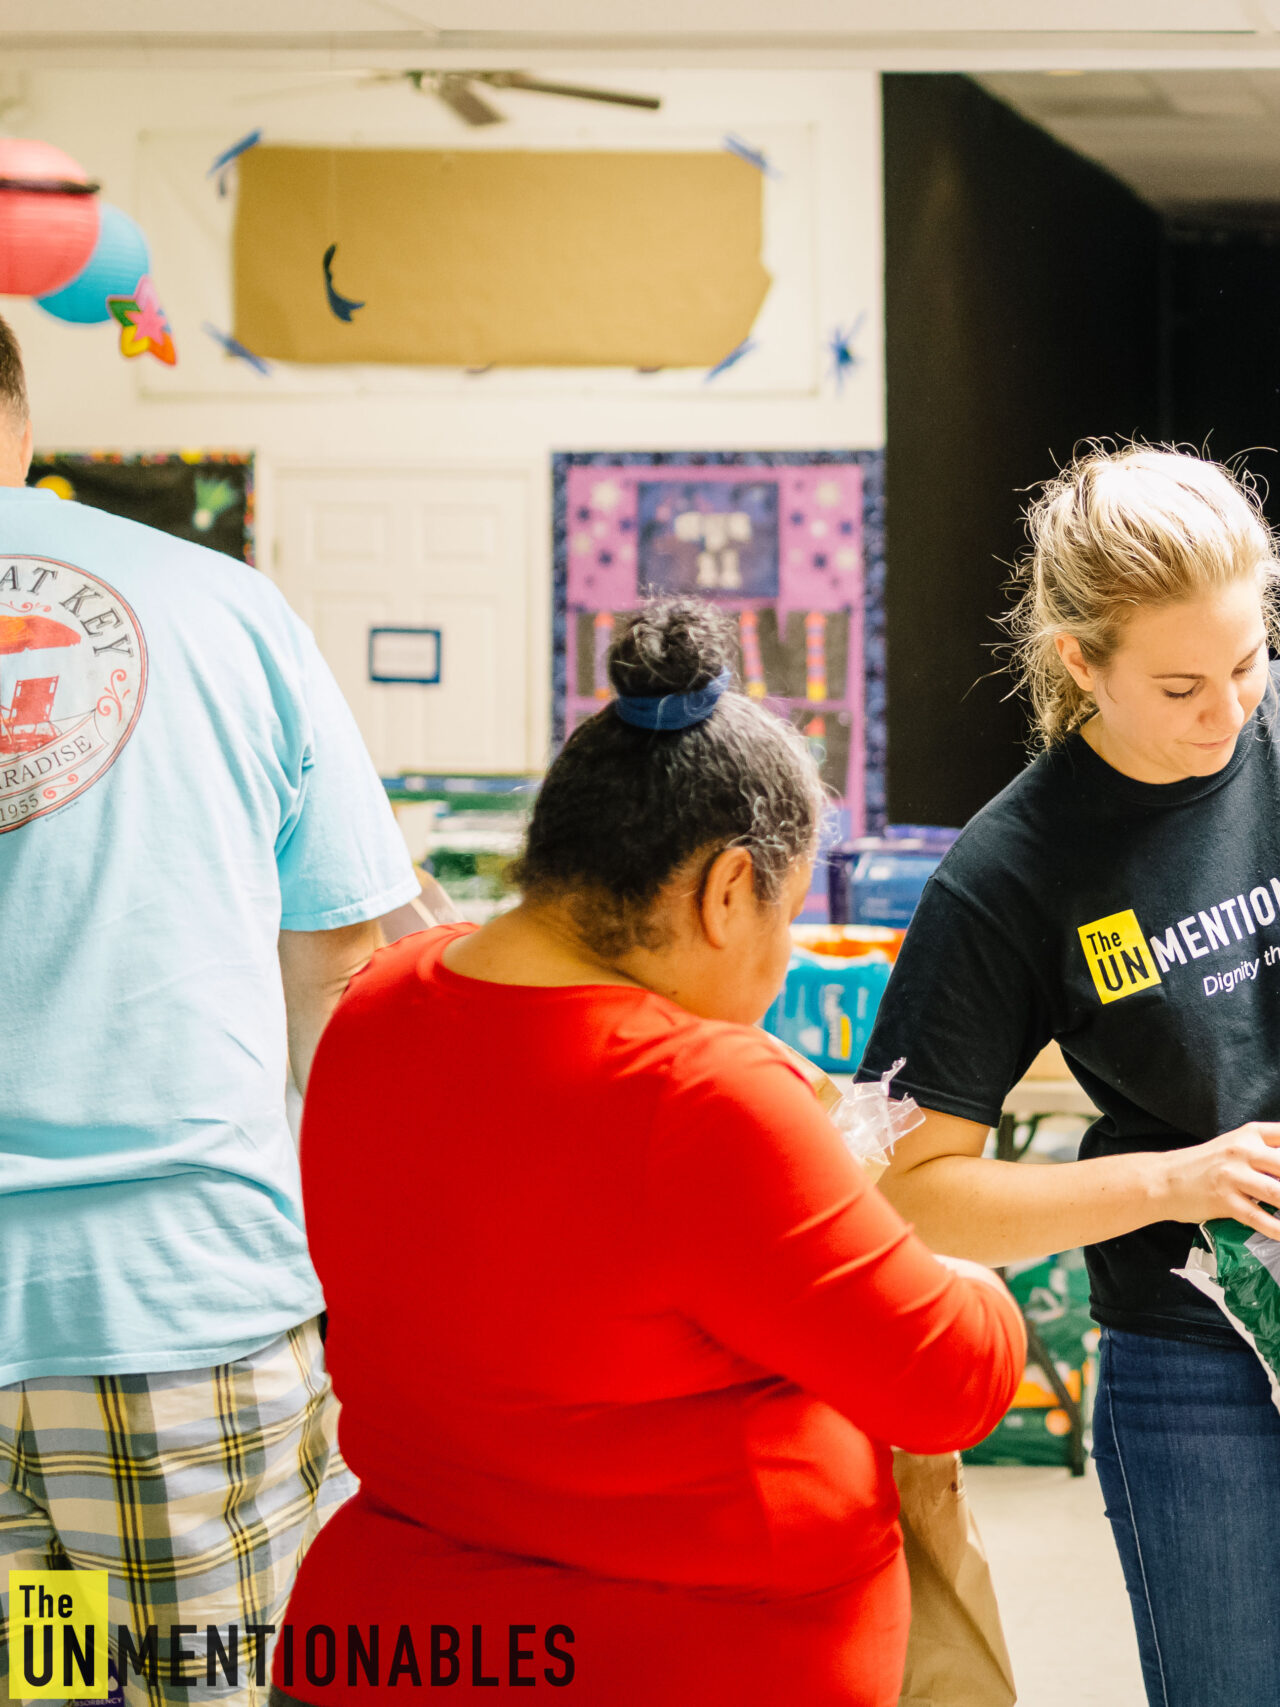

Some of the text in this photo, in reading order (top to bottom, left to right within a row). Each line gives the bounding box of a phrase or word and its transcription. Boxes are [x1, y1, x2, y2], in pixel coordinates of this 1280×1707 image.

[59, 584, 134, 657] KEY
[0, 735, 91, 789] RADISE
[0, 794, 39, 821] 1955
[1086, 927, 1123, 956] The
[1203, 957, 1260, 996] Dignity
